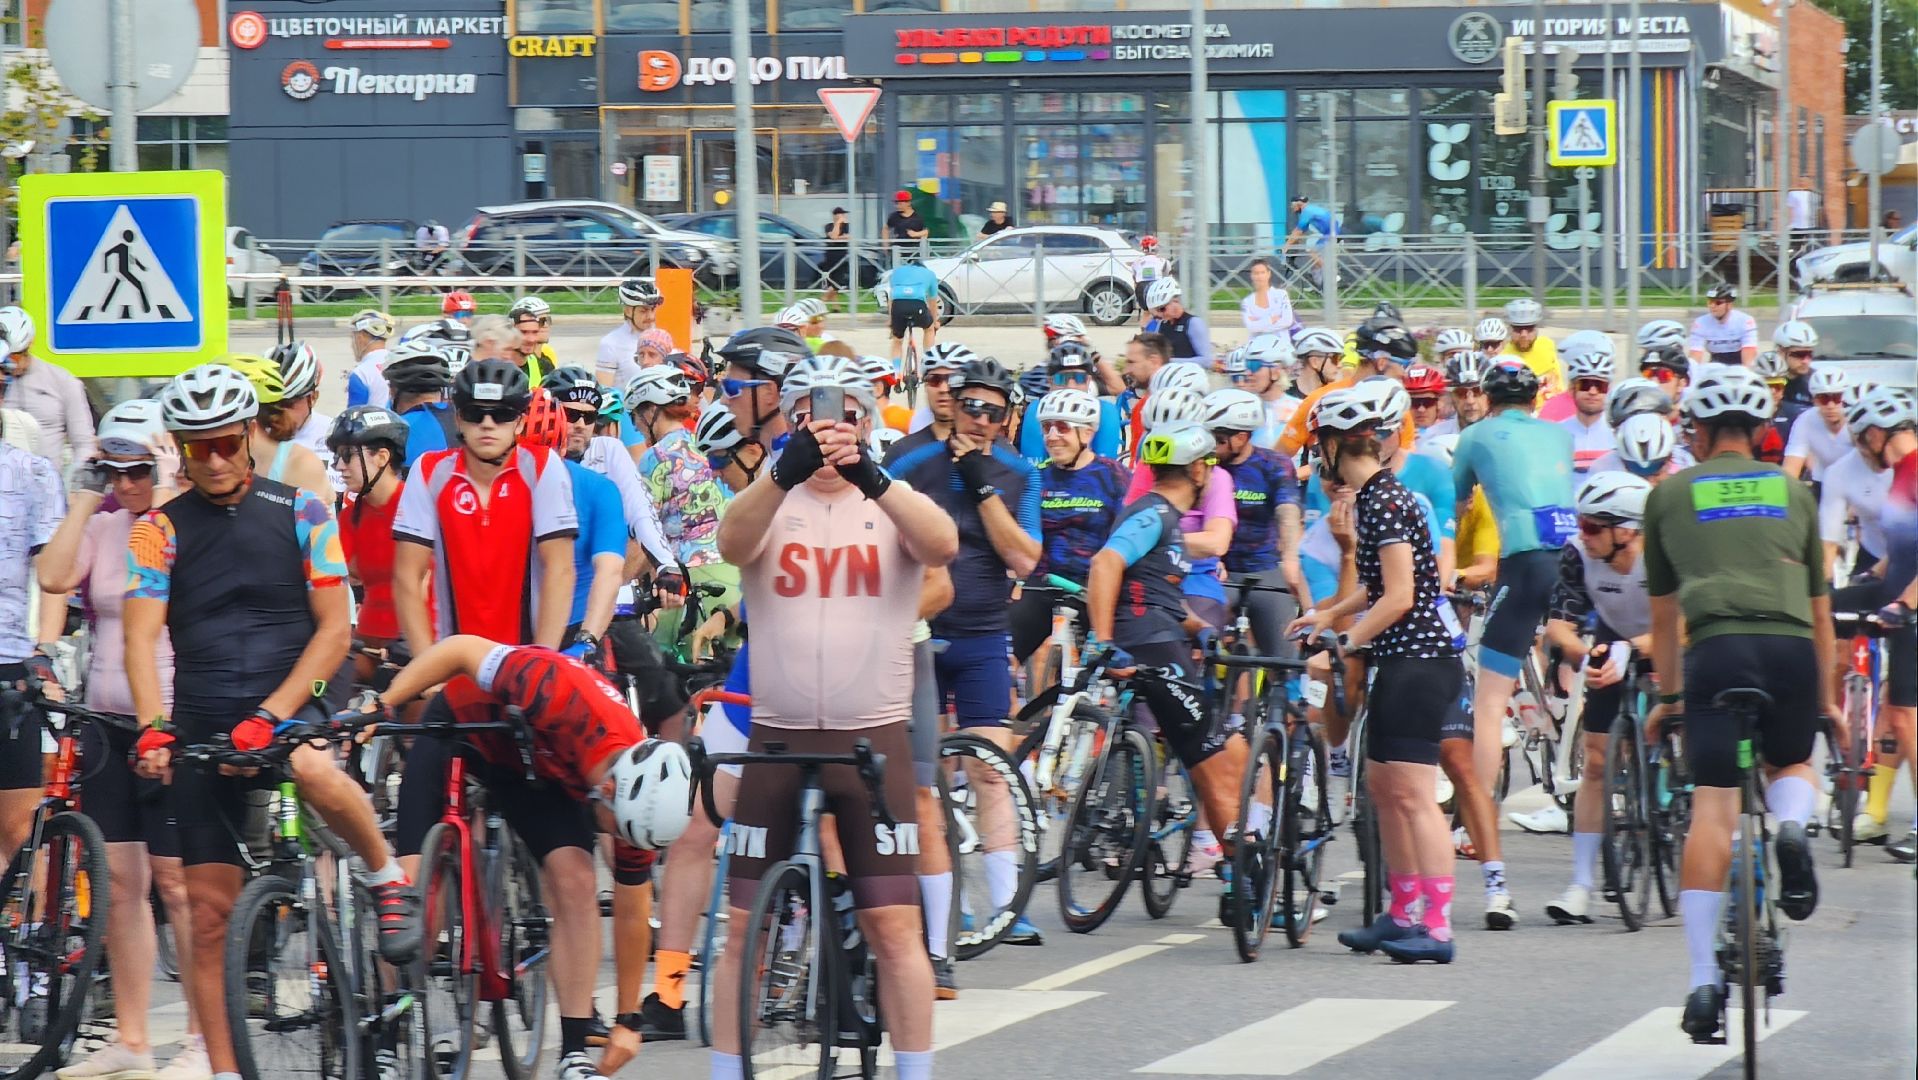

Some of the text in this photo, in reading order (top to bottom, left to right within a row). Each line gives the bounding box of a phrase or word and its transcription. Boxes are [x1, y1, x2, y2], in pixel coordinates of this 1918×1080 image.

[271, 14, 502, 37] ЦВЕТОЧНЫЙ МАРКЕТ
[1112, 23, 1231, 39] КОСМЕТКА
[508, 35, 597, 57] CRAFT
[1115, 44, 1193, 59] БЫТОВА
[324, 66, 478, 101] Пекарня
[1719, 480, 1759, 496] 357
[773, 542, 882, 598] SYN
